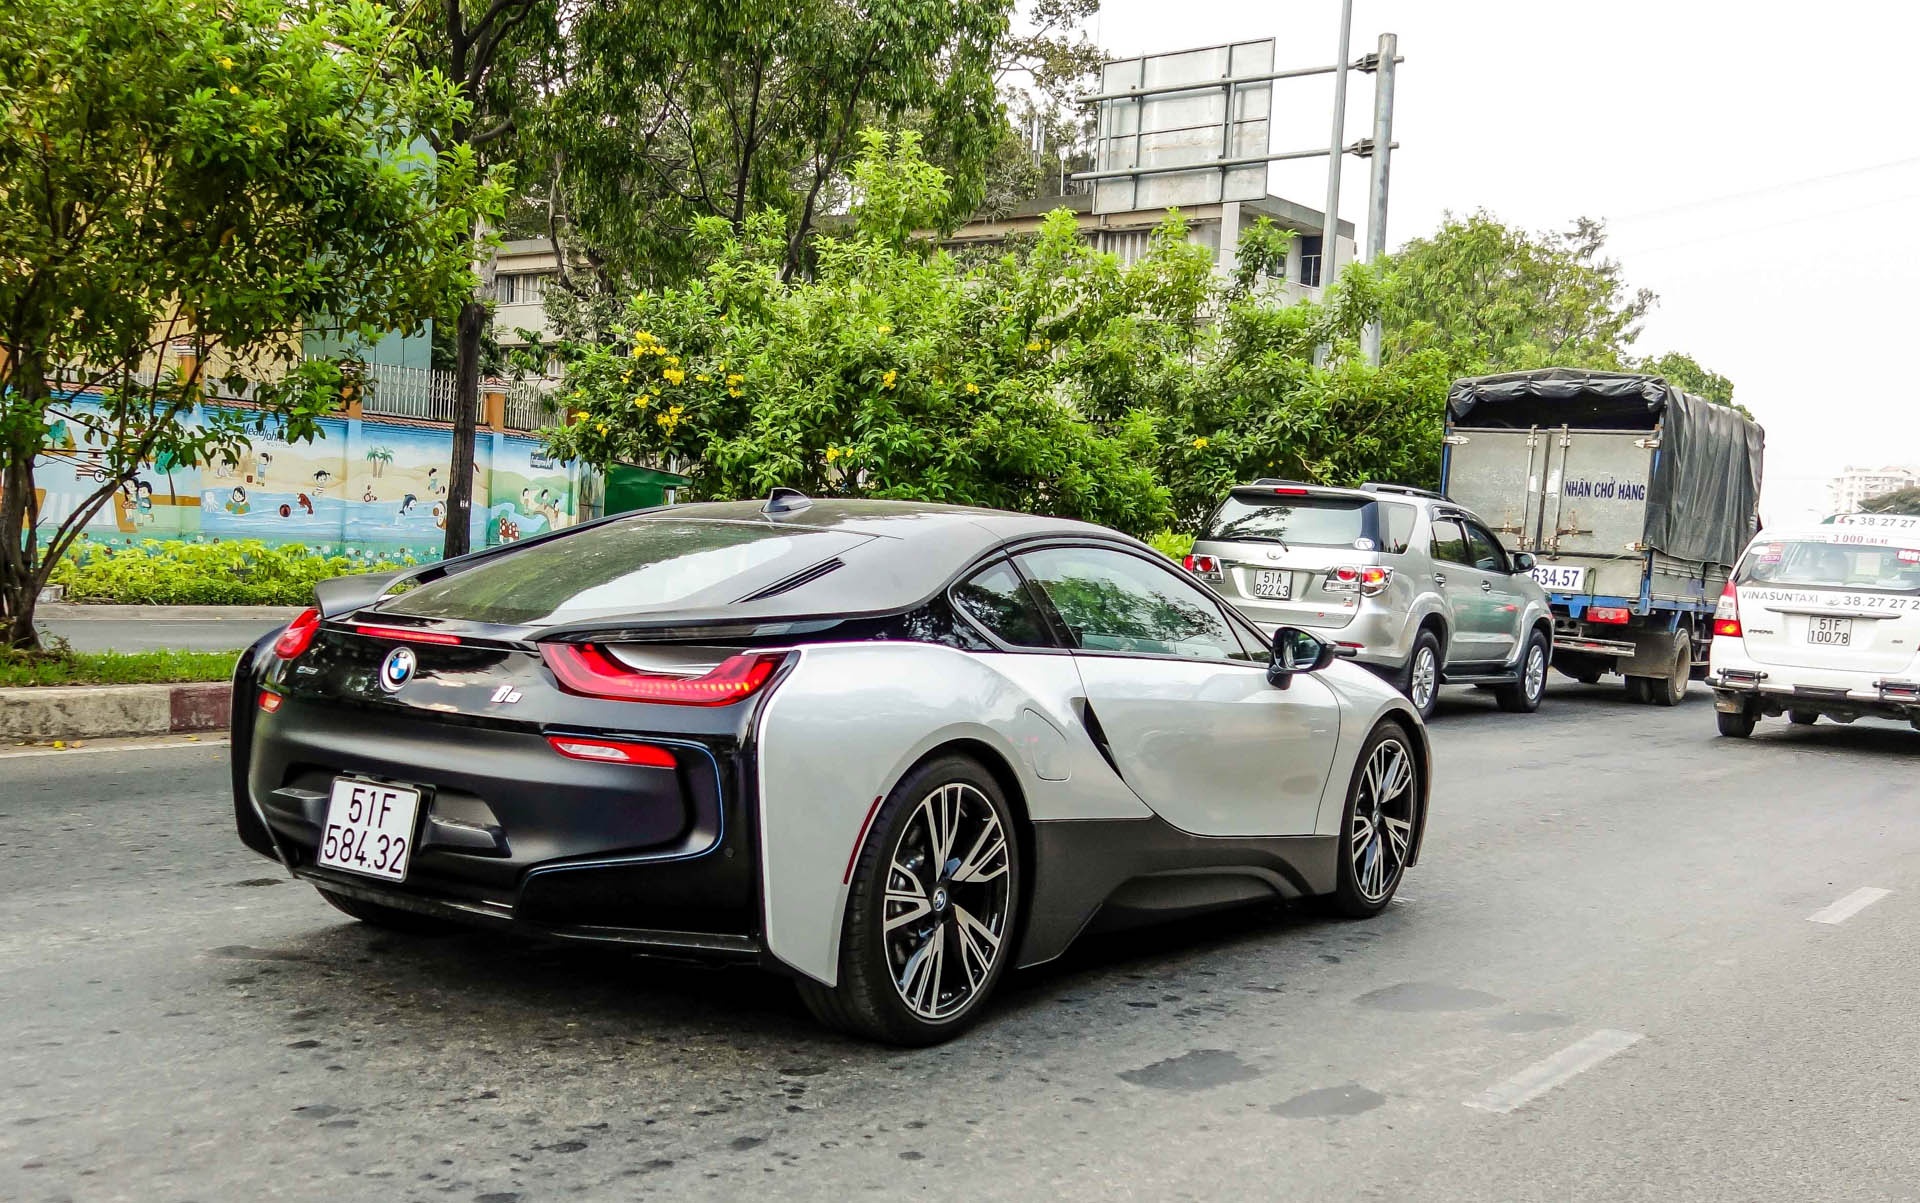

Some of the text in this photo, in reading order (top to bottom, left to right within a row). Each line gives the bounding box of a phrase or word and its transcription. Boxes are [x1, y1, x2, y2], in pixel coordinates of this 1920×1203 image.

[1564, 476, 1646, 501] NHẬN CHỞ HÀNG
[1263, 571, 1282, 584] 51A
[1532, 567, 1580, 587] 634.57
[1819, 618, 1843, 631] 51F
[348, 787, 397, 829] 51F
[324, 823, 406, 875] 584.32
